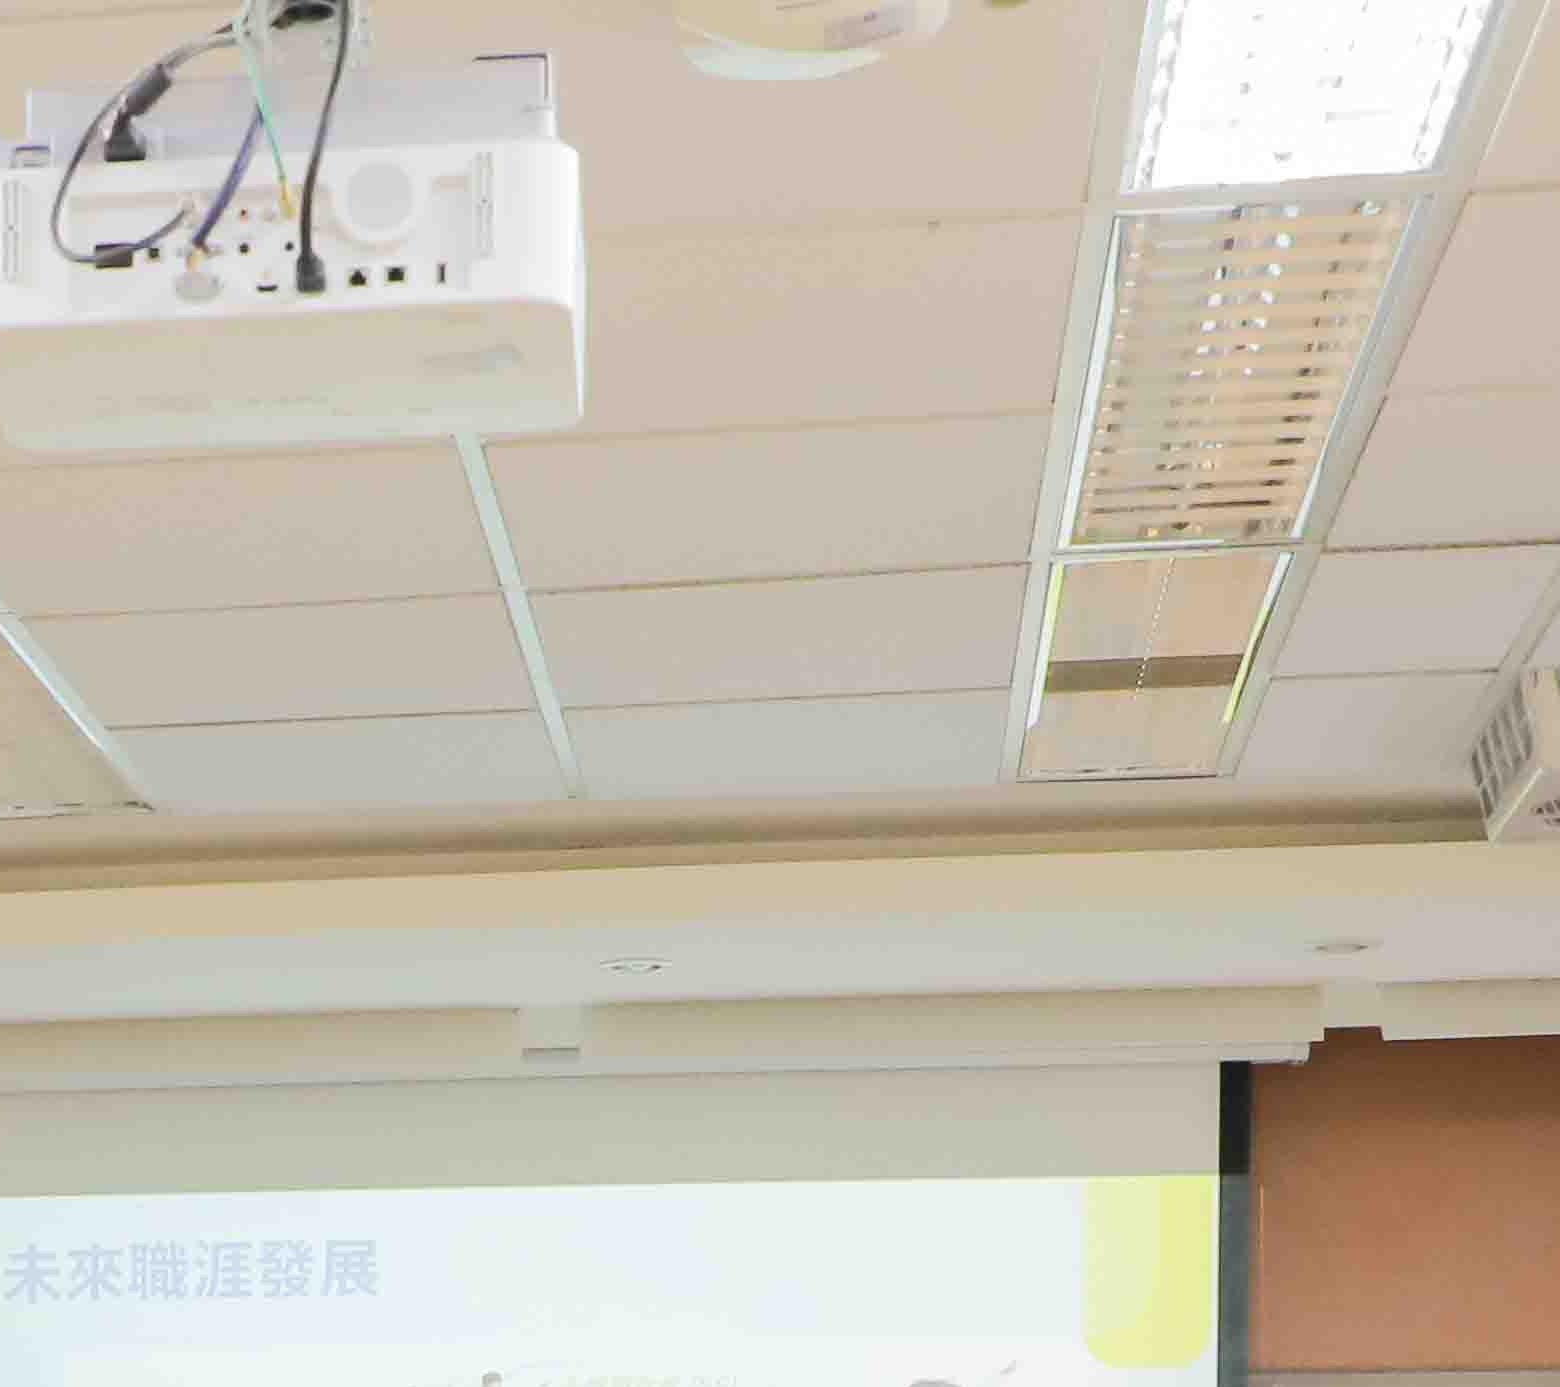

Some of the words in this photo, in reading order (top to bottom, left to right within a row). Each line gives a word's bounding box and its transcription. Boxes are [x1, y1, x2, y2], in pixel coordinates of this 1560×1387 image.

[4, 1238, 378, 1304] 未來職涯發展
